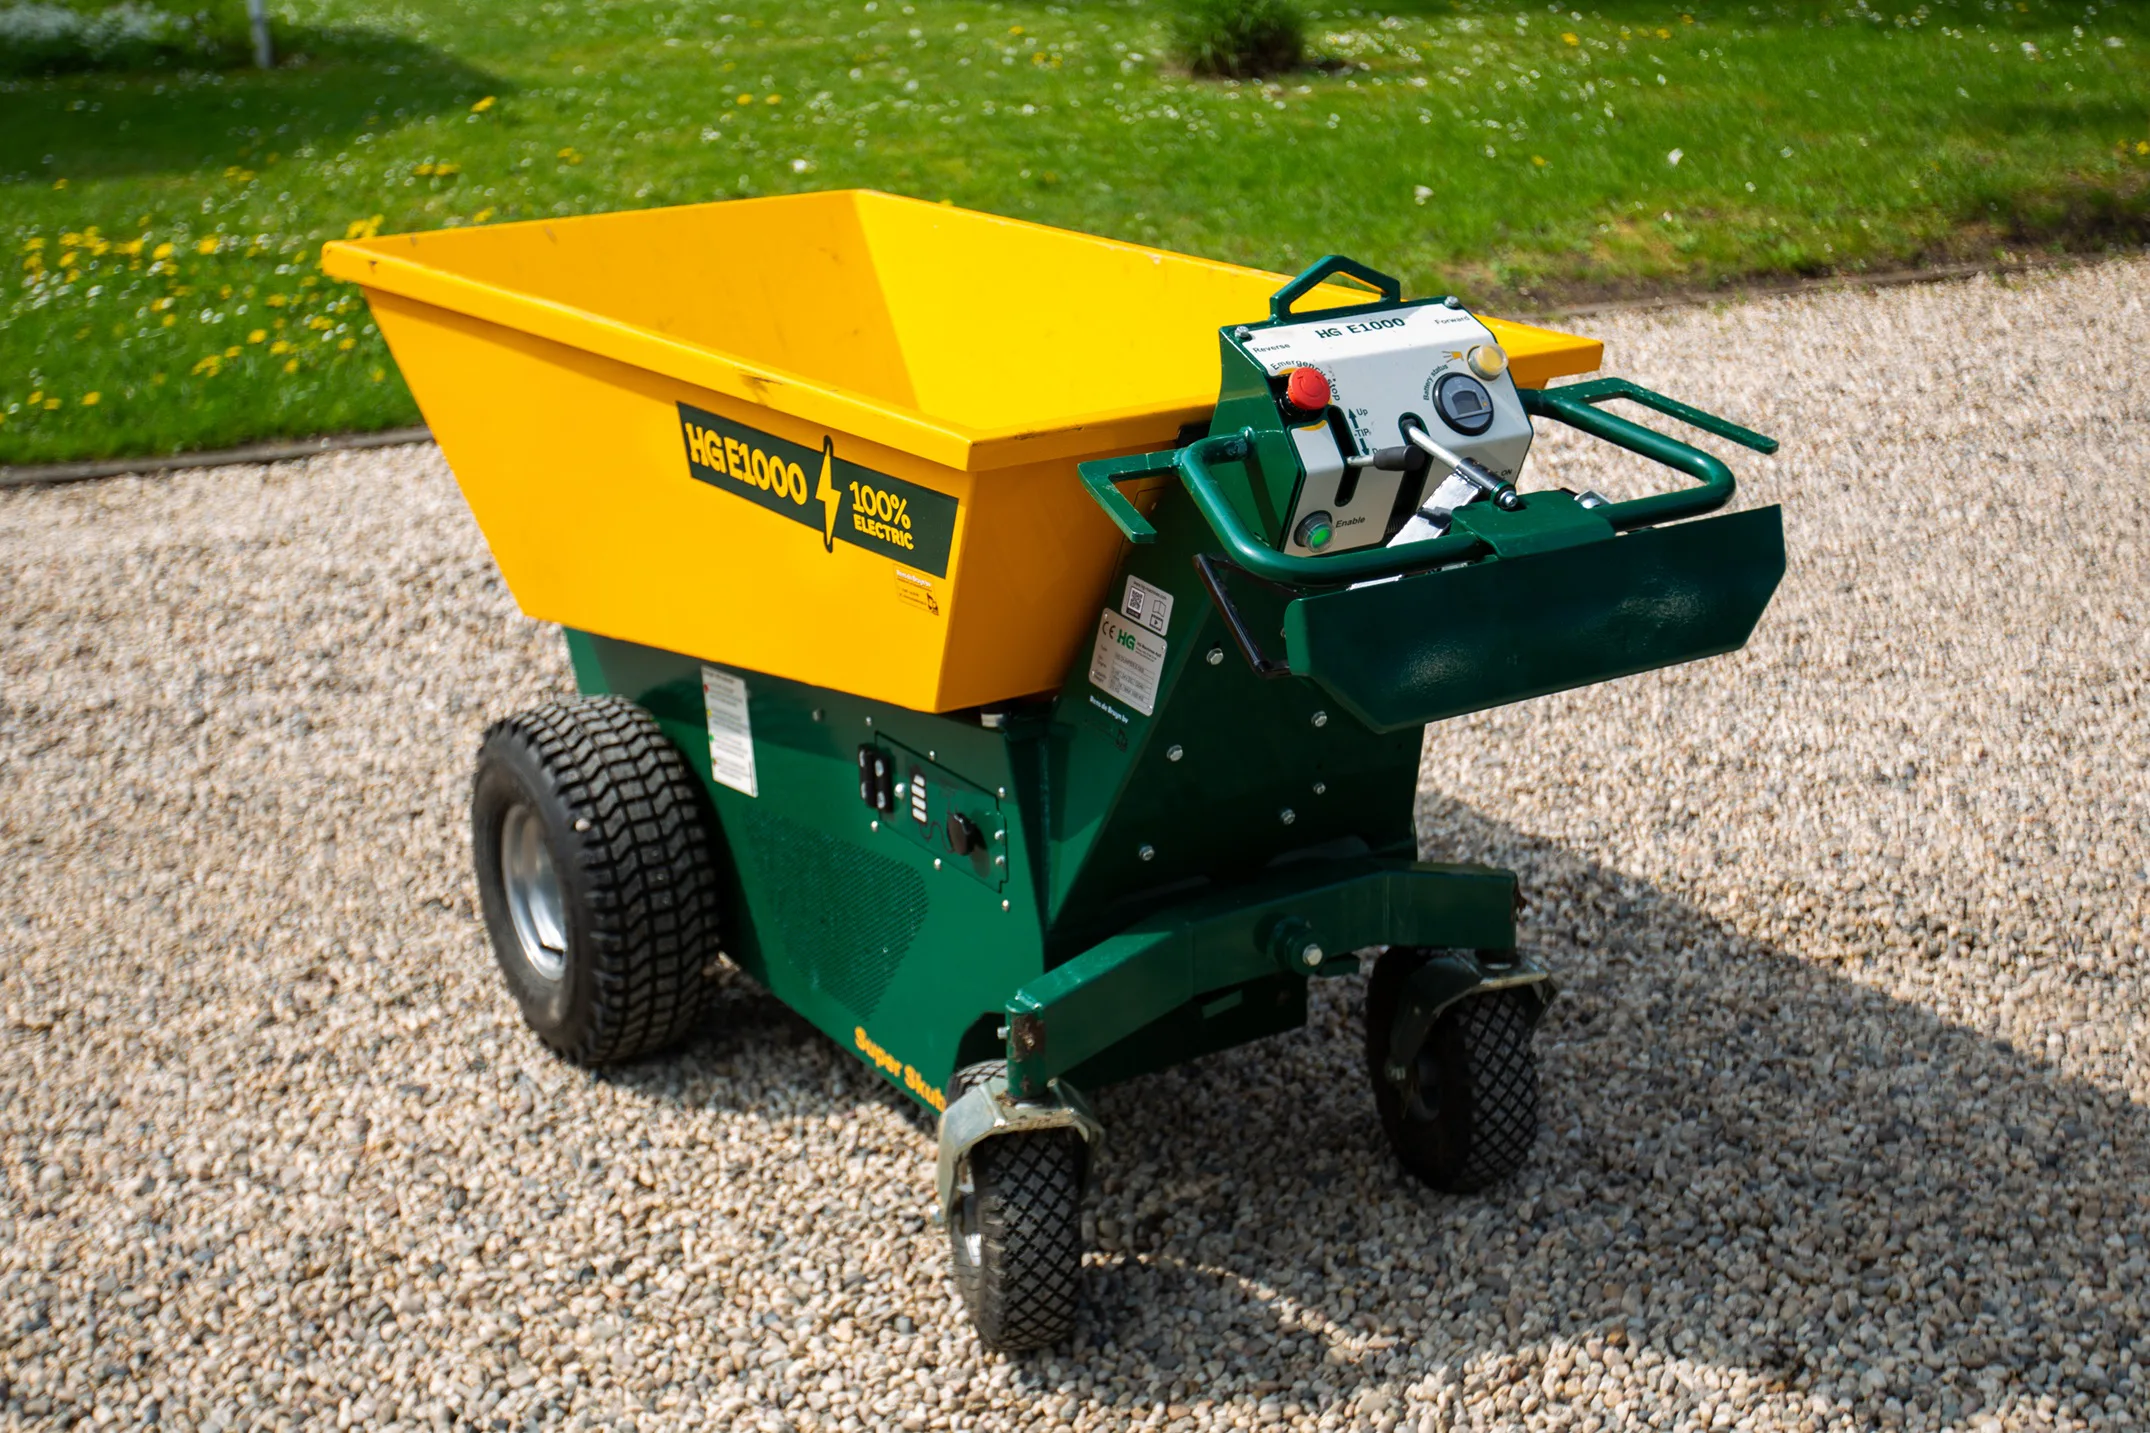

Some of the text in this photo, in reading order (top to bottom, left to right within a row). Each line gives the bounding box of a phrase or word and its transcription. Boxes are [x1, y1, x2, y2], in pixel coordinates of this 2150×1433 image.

[1314, 317, 1406, 339] HG E1000
[1434, 315, 1470, 324] Forward
[1252, 343, 1291, 353] Reverse
[1422, 364, 1449, 401] Battery status
[1356, 408, 1369, 417] Up
[849, 480, 912, 530] 100%
[852, 513, 915, 551] ELECTRIC
[1335, 516, 1366, 528] Enable
[1117, 628, 1137, 651] HG
[854, 1025, 903, 1078] Super
